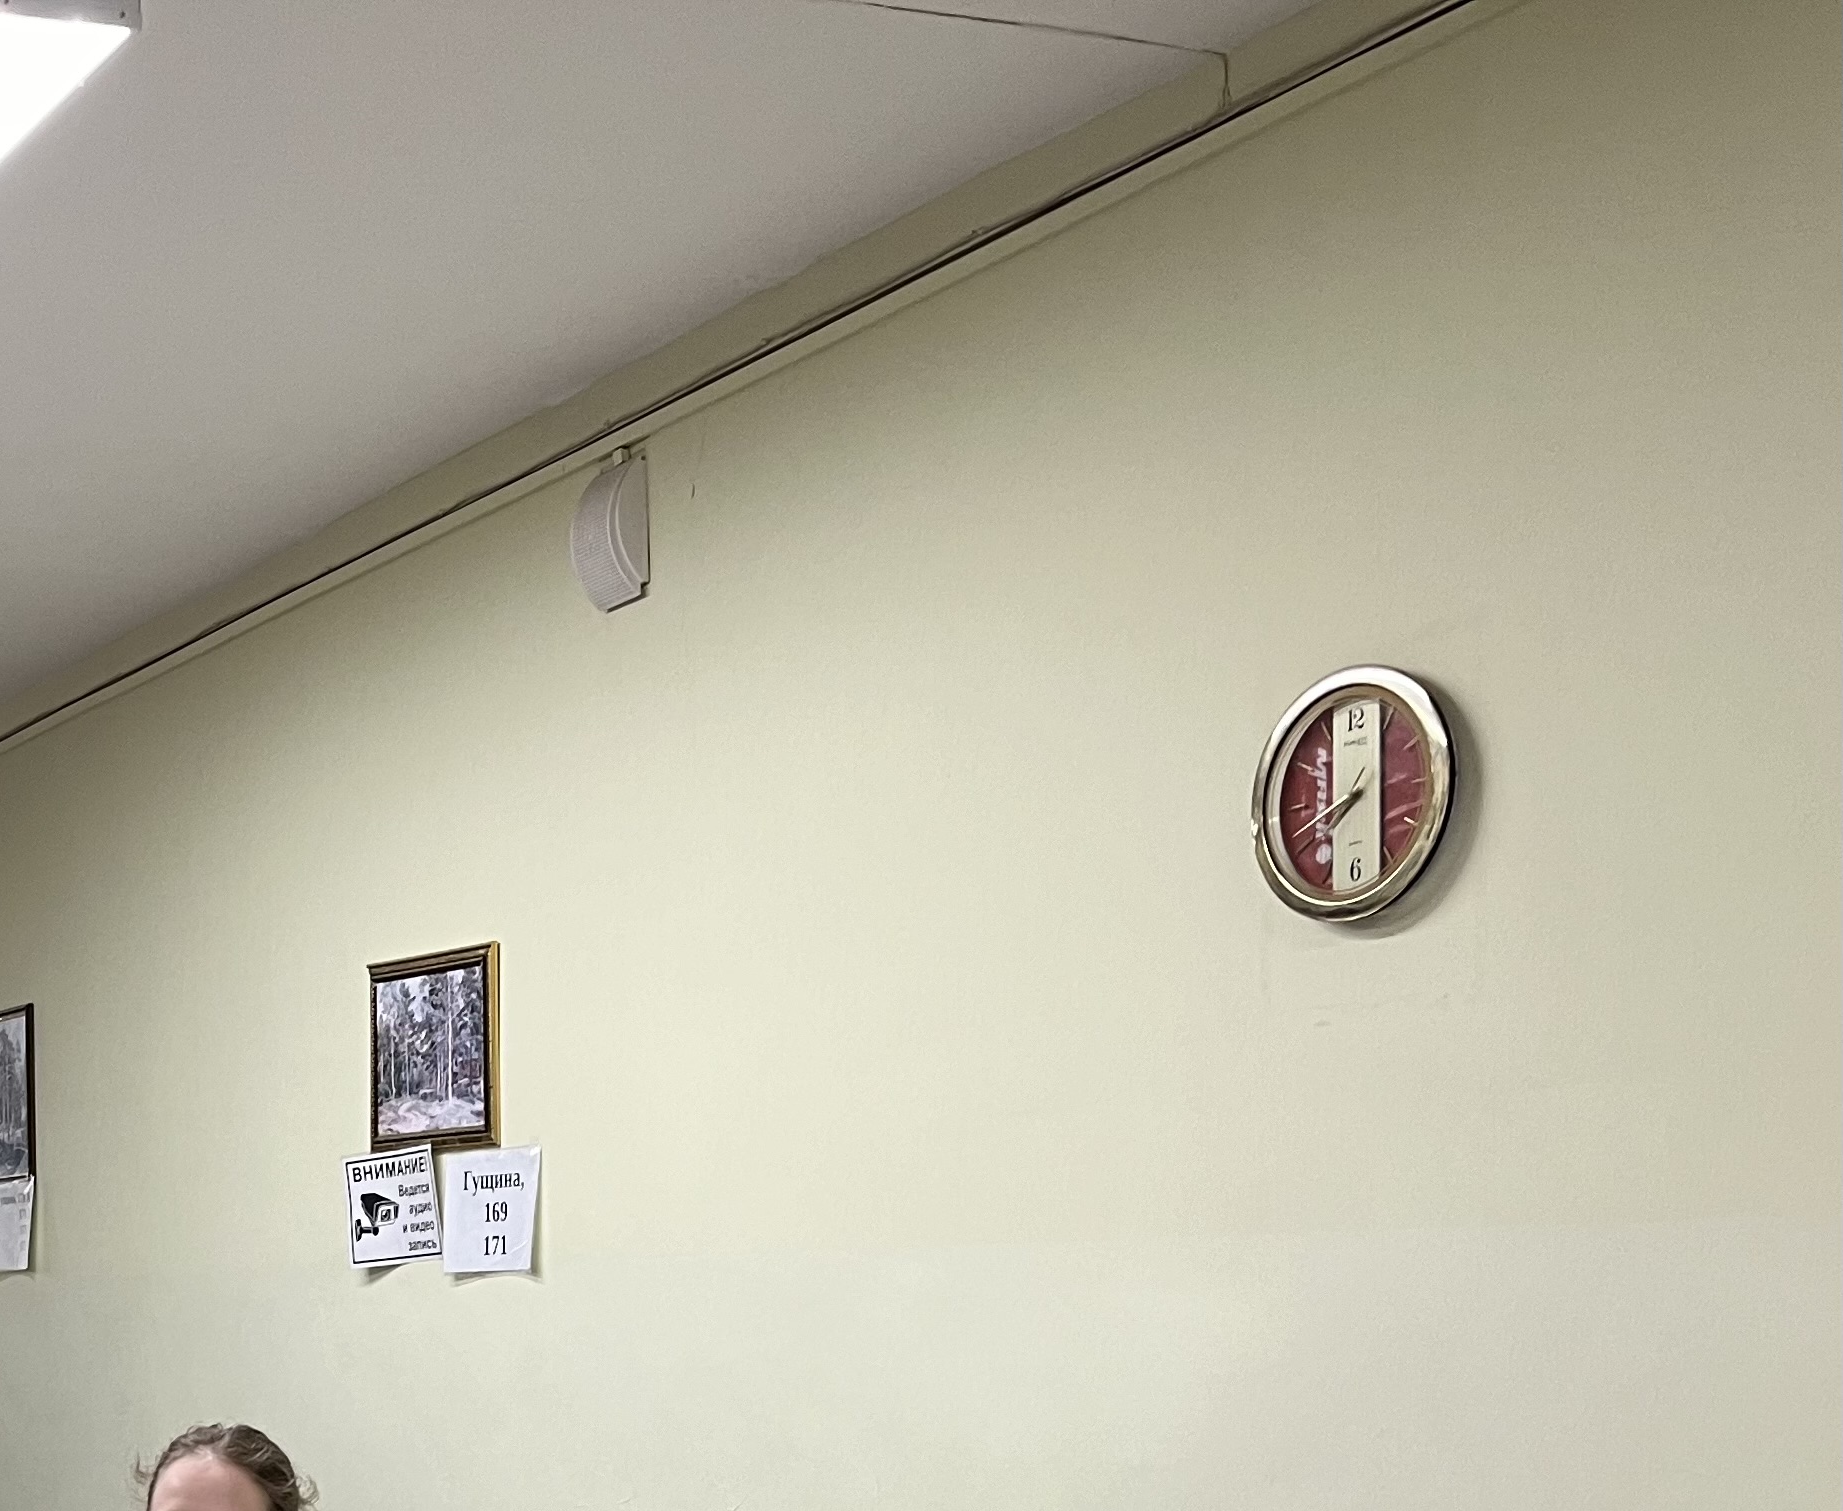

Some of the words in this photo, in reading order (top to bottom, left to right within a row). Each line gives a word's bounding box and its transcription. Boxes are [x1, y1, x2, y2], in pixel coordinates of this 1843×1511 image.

[1348, 707, 1365, 732] 12
[1350, 857, 1362, 882] 6
[463, 1171, 524, 1196] Гущина,
[485, 1201, 508, 1222] 169
[484, 1235, 507, 1255] 171
